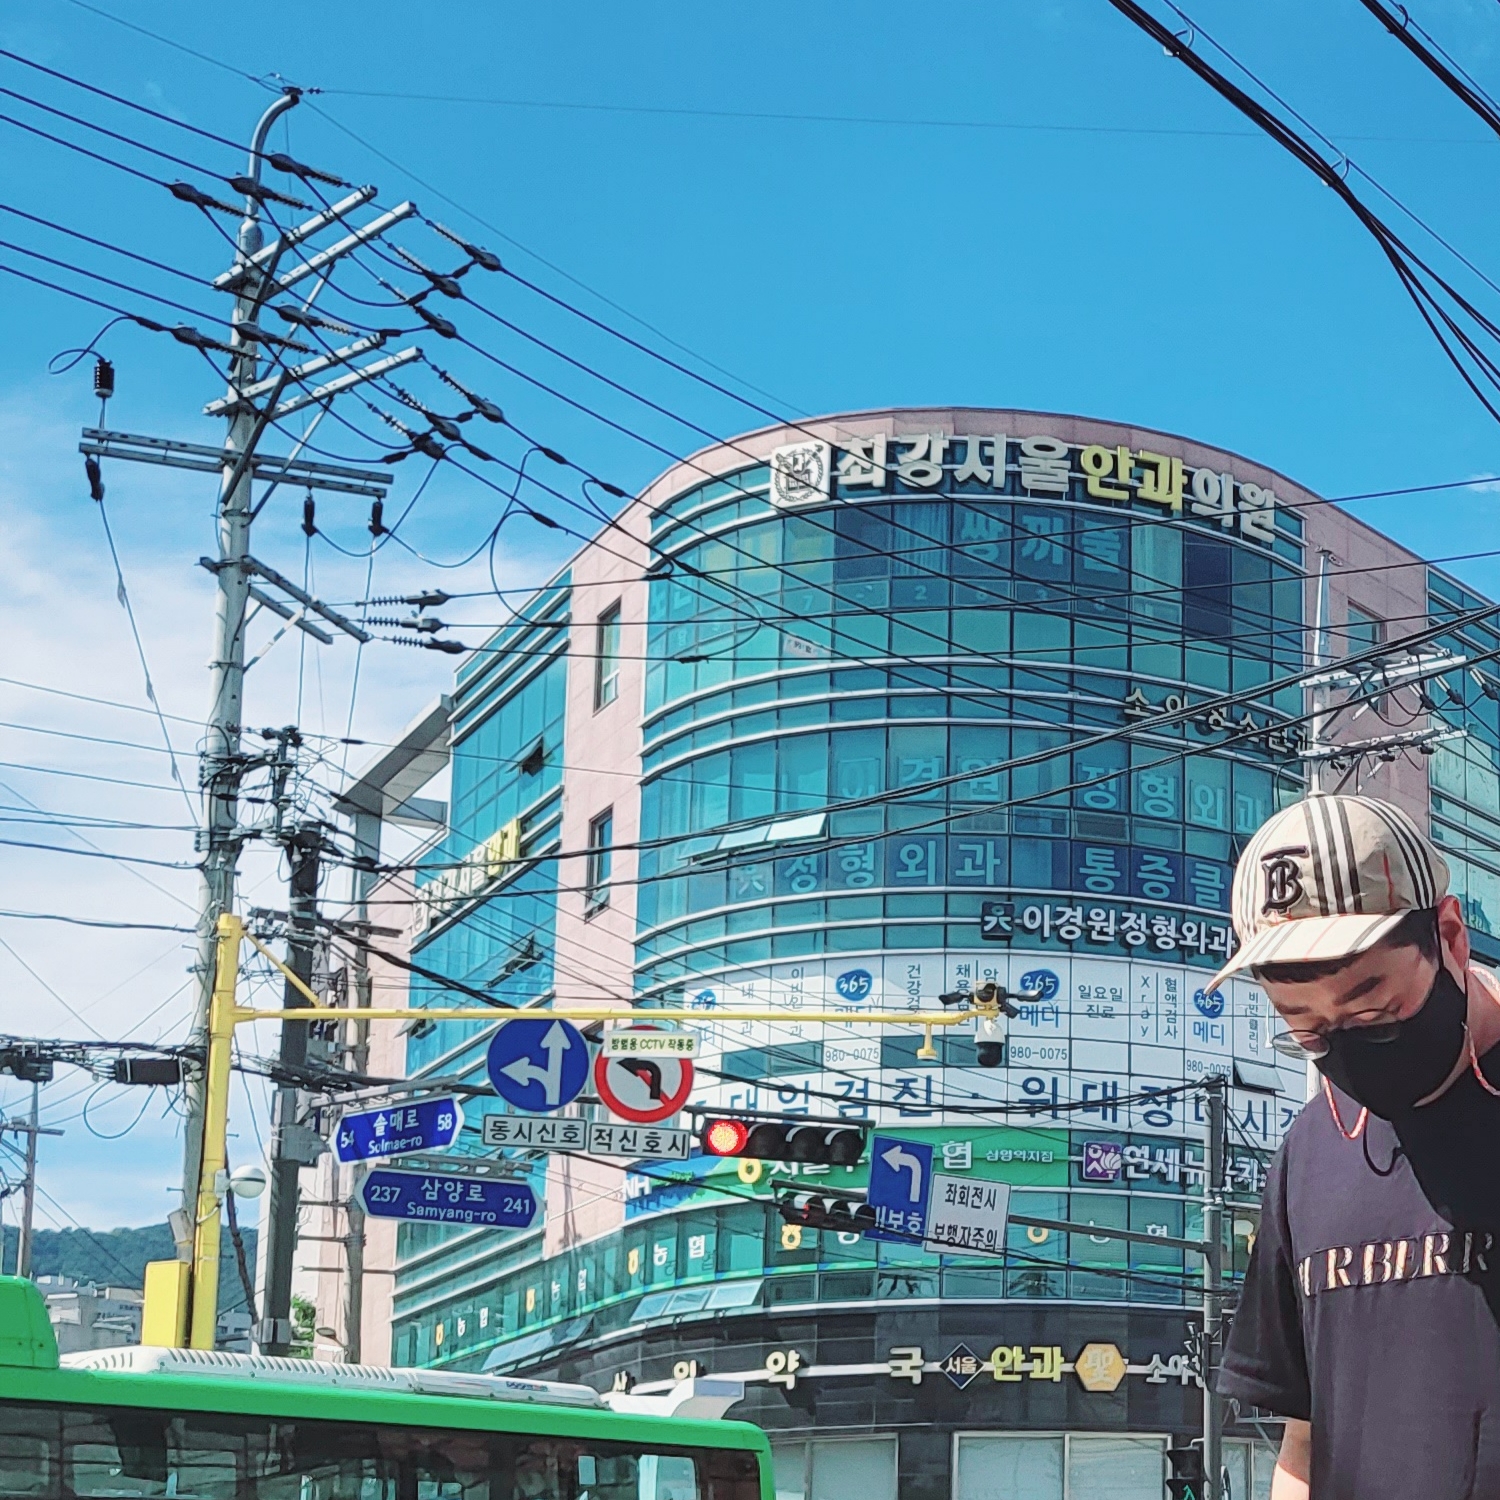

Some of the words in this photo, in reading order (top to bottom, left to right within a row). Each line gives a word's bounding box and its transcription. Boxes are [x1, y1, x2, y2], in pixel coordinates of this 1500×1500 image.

[836, 433, 1276, 544] 최강서울안과의원
[1022, 903, 1239, 957] 이경원정형외과
[1078, 984, 1123, 1002] 일요일
[1019, 1004, 1060, 1028] 메디
[639, 1038, 666, 1051] CCTV
[667, 1038, 694, 1052] 작동중
[1192, 1020, 1225, 1047] 메디
[825, 1048, 880, 1063] 980-0075
[1010, 1046, 1068, 1061] 980-0075
[1186, 1059, 1232, 1078] 980-0075
[372, 1108, 420, 1139] 솔매로
[437, 1112, 453, 1133] 58
[489, 1119, 581, 1146] 동시신호
[367, 1133, 423, 1156] Solmae-ro
[593, 1126, 688, 1158] 적신호시
[370, 1184, 402, 1204] 237
[420, 1178, 487, 1205] 삼양로
[623, 1174, 653, 1200] NH
[944, 1182, 998, 1212] 좌회전시
[406, 1200, 498, 1224] Samyang-ro
[503, 1196, 531, 1216] 241
[944, 1355, 977, 1375] 서울
[991, 1345, 1064, 1383] 안과
